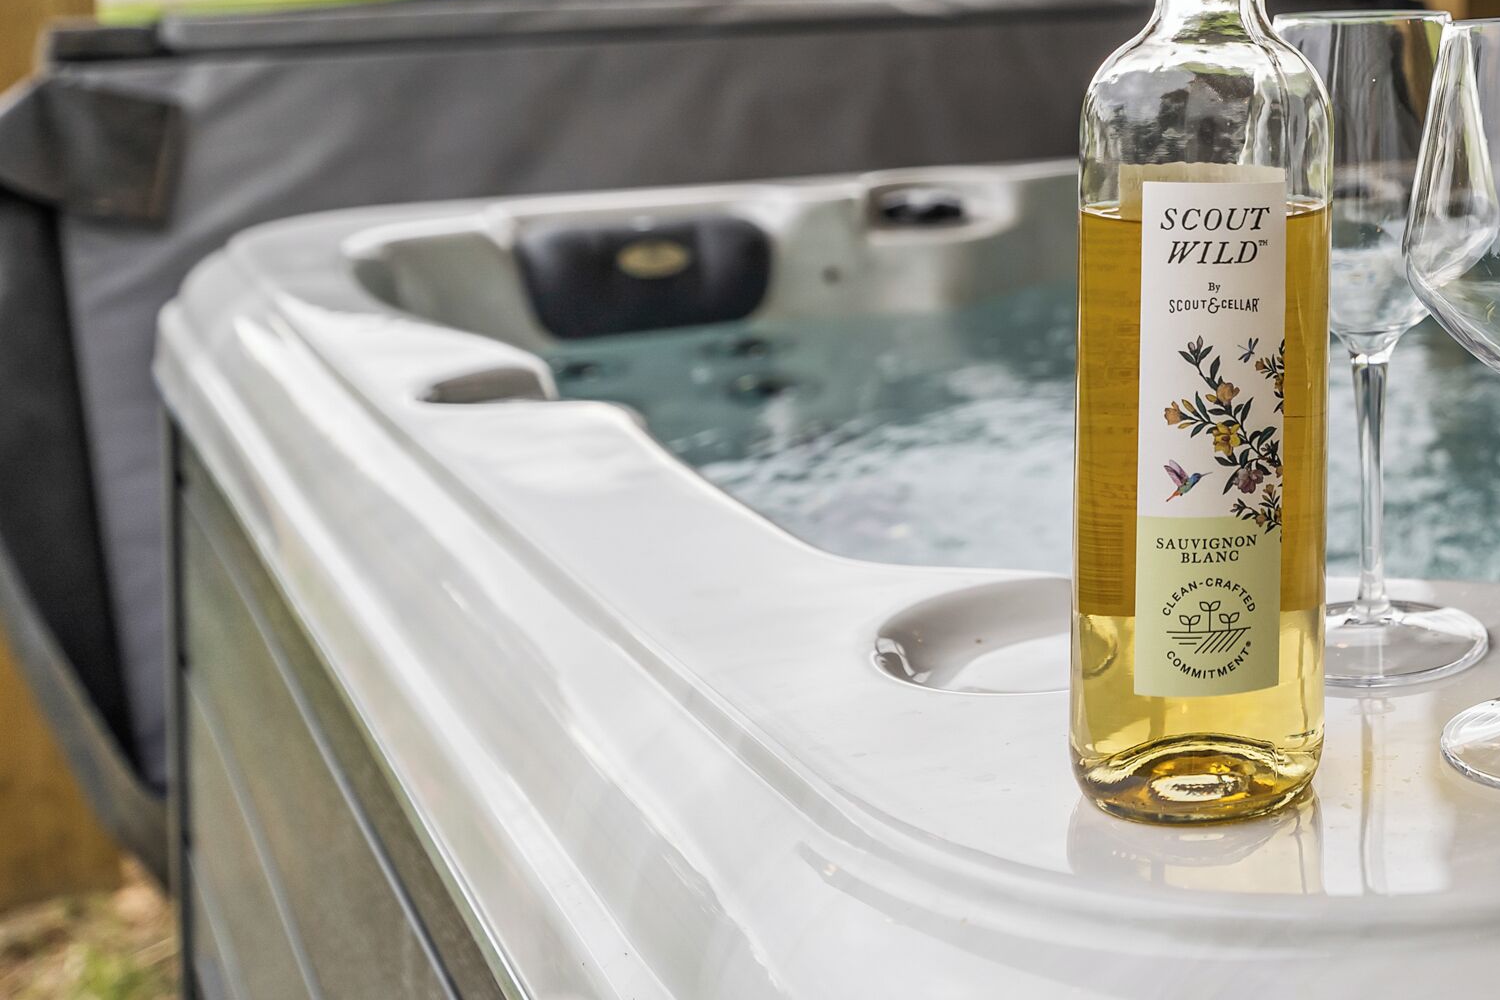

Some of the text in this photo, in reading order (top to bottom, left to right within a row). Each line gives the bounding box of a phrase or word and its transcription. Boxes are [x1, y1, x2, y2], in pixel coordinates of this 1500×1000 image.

[1160, 207, 1270, 231] SCOUT
[1208, 282, 1221, 293] By
[1156, 534, 1257, 550] SAUVIGNON
[1180, 550, 1240, 564] BLANC
[1162, 577, 1256, 617] CLEAN-CRAFTED
